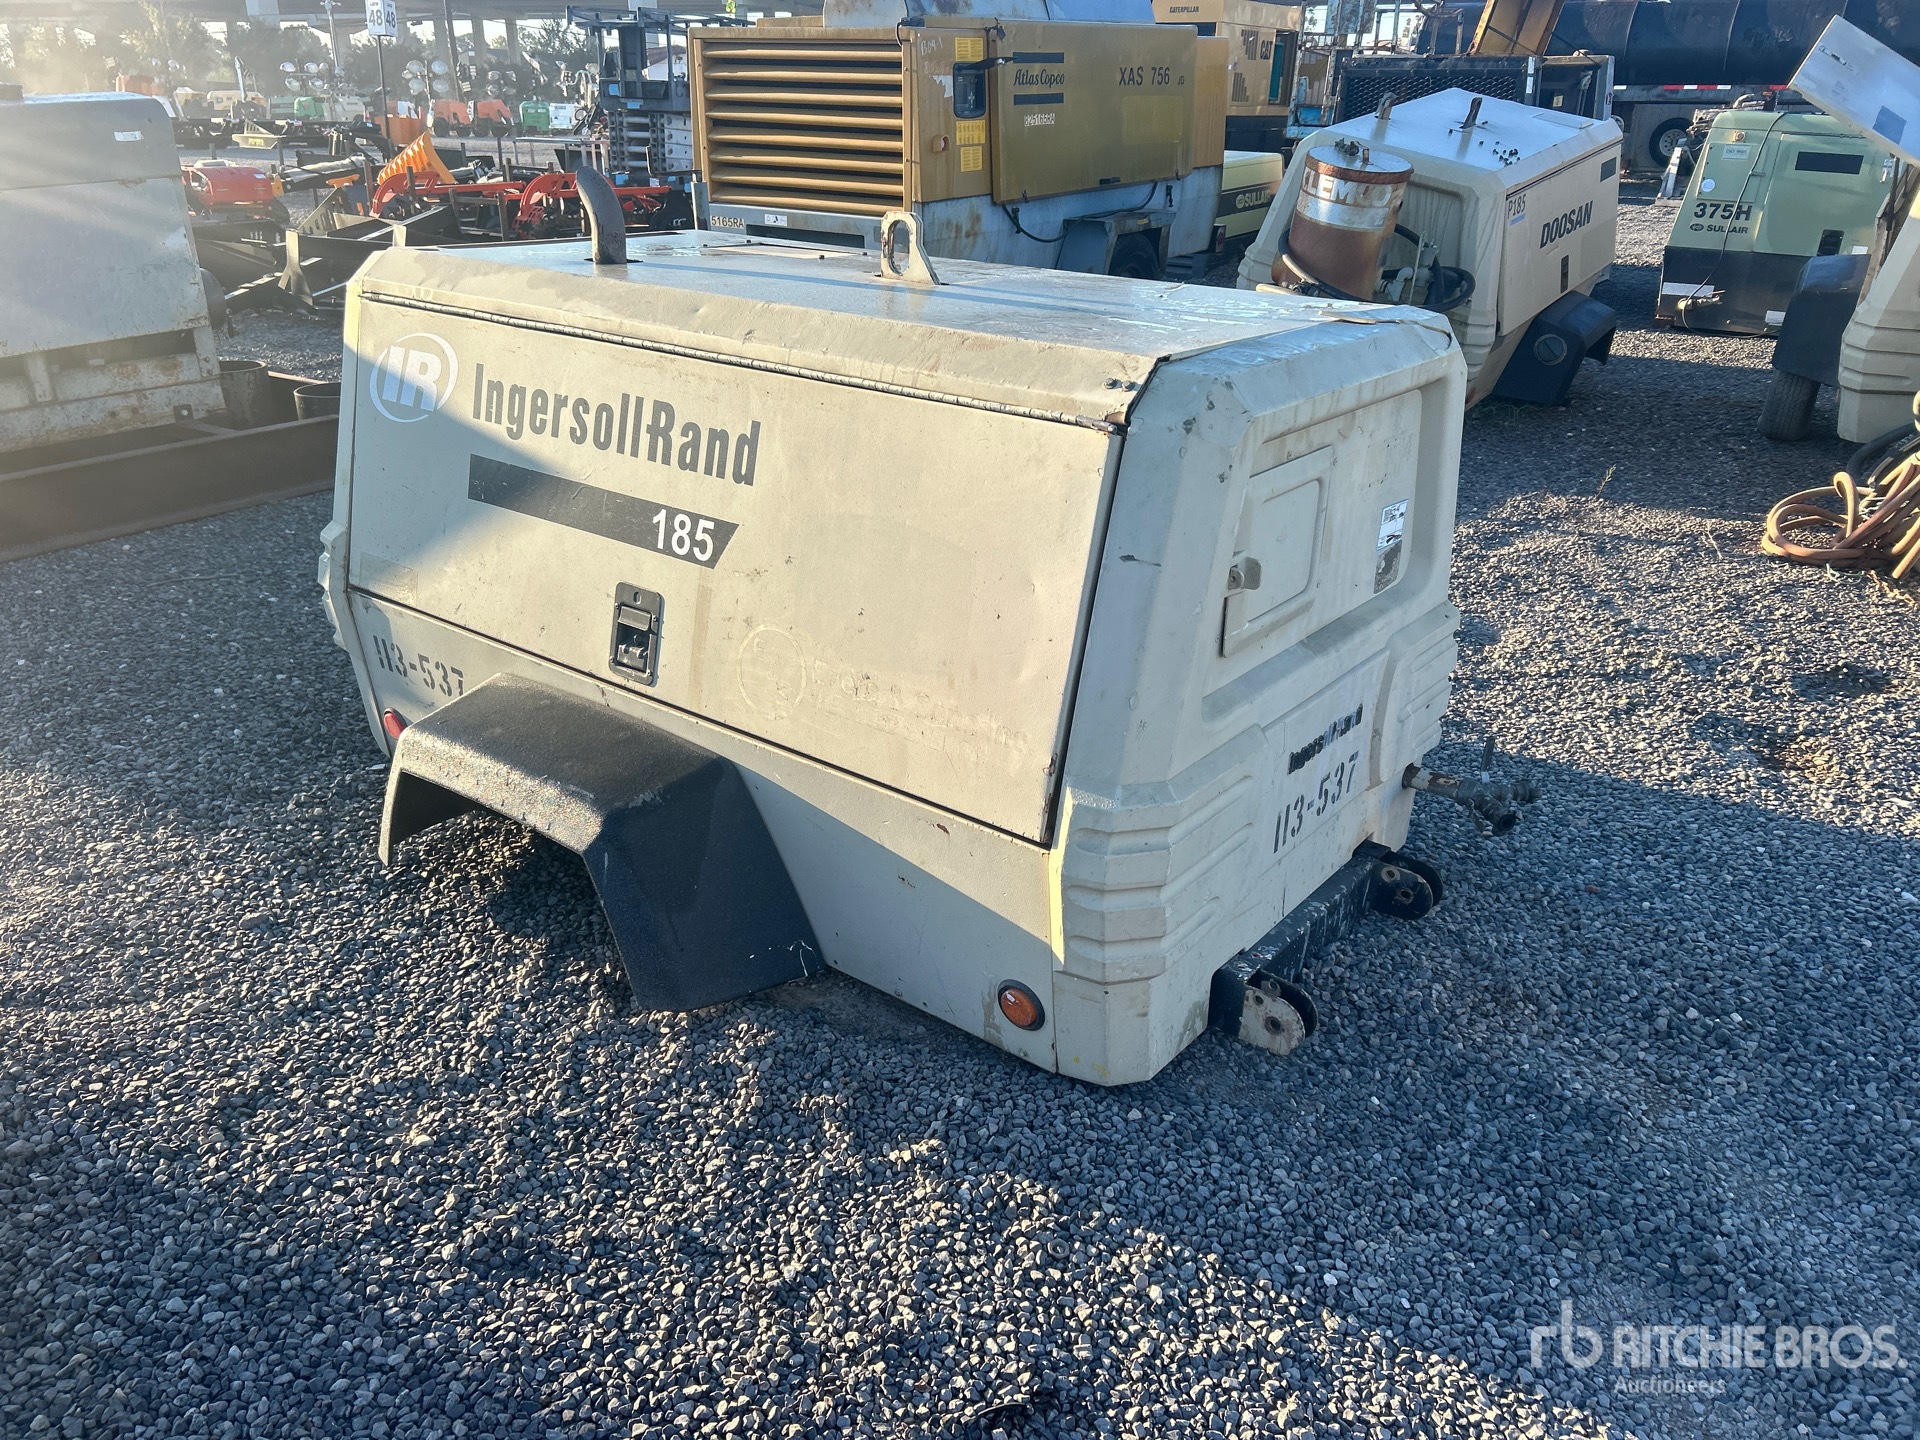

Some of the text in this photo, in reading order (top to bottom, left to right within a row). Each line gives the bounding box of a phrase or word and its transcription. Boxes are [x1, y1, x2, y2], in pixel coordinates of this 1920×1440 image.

[369, 9, 384, 26] 48
[386, 11, 396, 28] 48
[1260, 40, 1273, 60] CAT
[1013, 69, 1065, 88] Atlas Copco
[1119, 66, 1144, 86] XAS
[1151, 67, 1170, 85] 756
[1302, 166, 1392, 207] CLEMCO
[1507, 194, 1526, 218] P185
[1693, 202, 1753, 221] 375H
[711, 215, 744, 228] 5165RA
[1540, 200, 1593, 249] DOOSAN
[652, 508, 716, 562] 185
[373, 635, 464, 697] 113-537
[1273, 750, 1359, 854] 113-537
